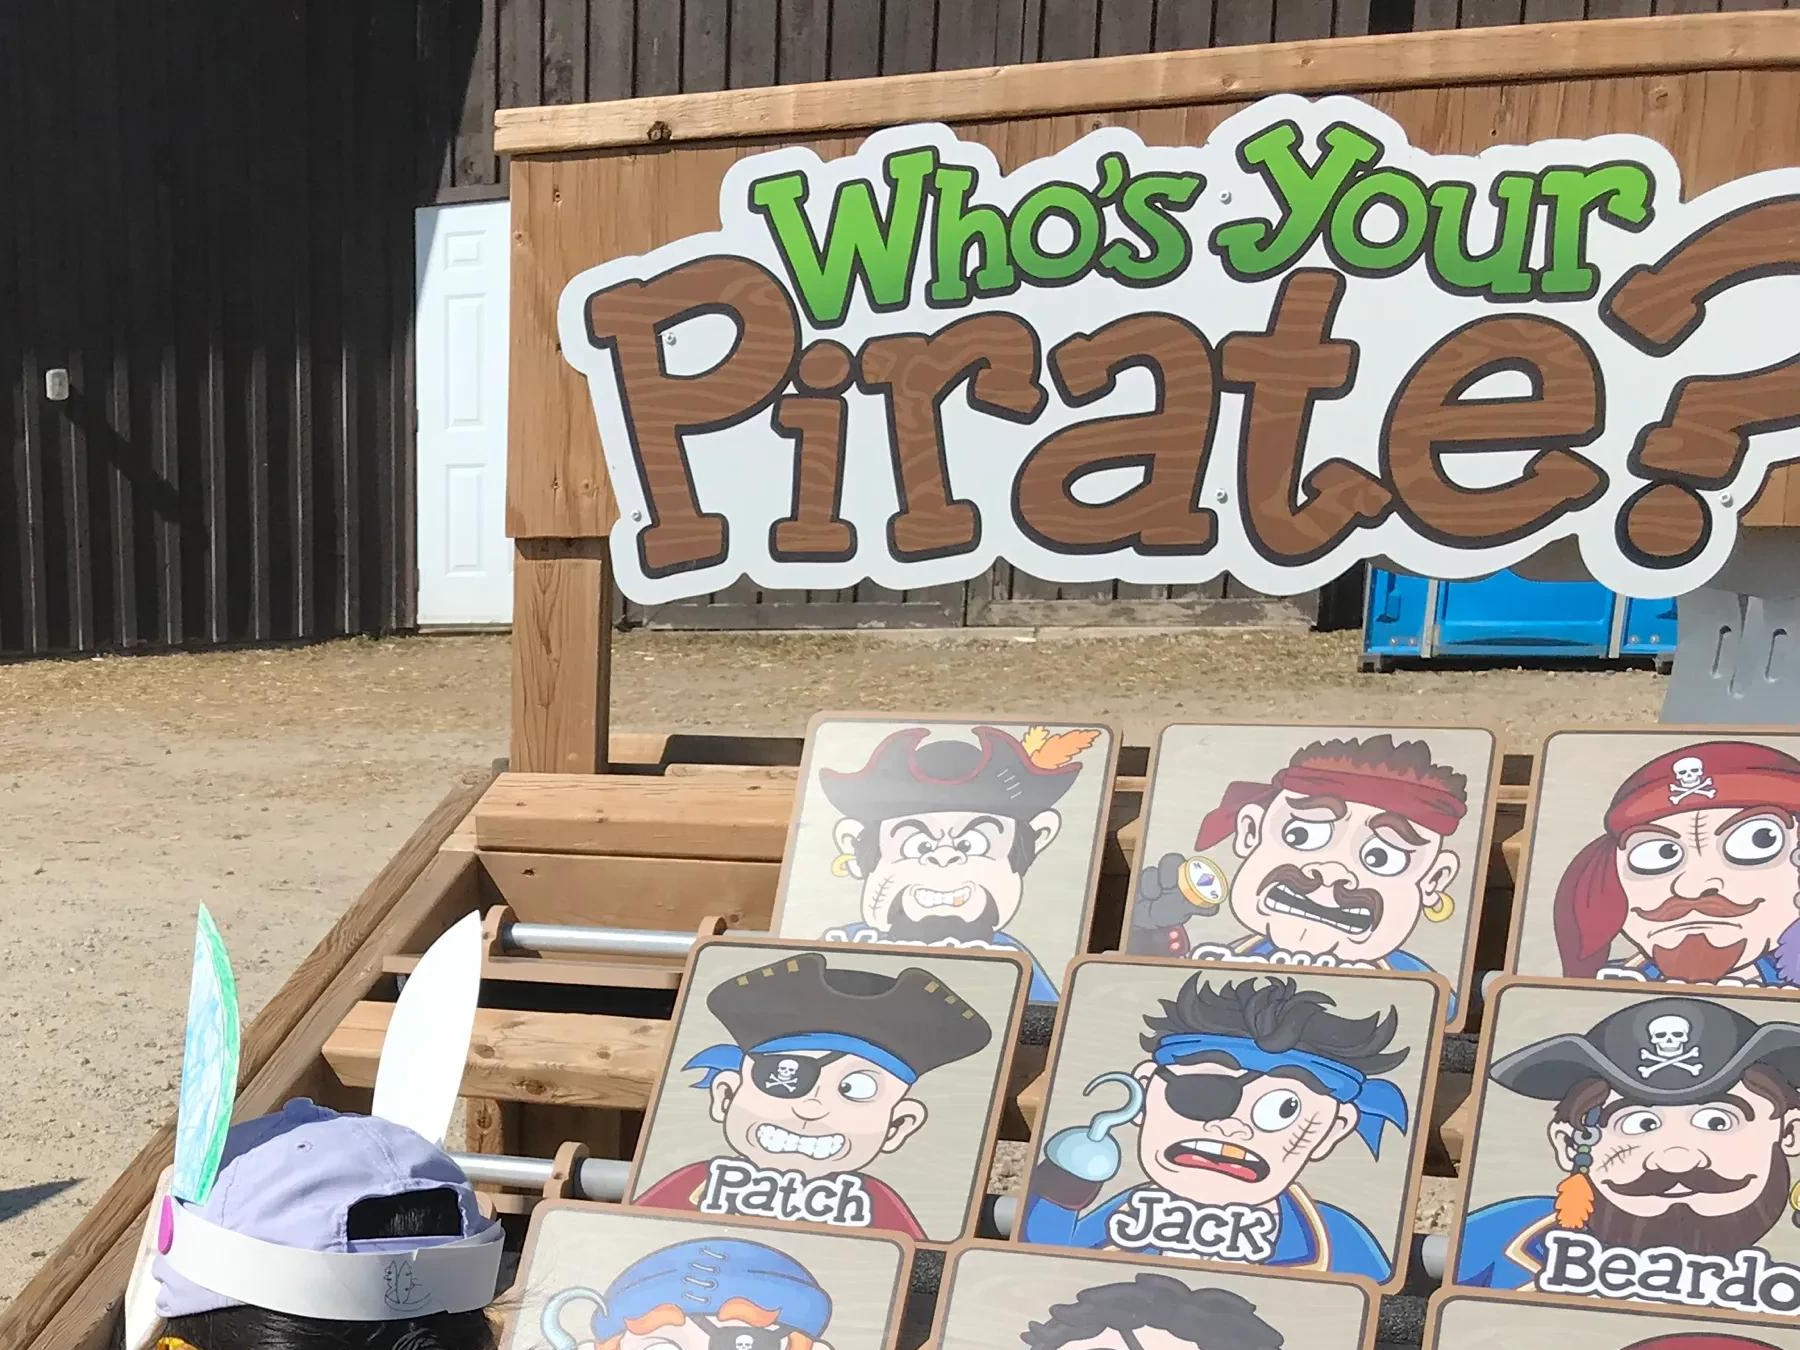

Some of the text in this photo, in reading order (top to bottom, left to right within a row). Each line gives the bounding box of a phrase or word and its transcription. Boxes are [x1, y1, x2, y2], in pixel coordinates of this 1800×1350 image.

[748, 145, 1199, 330] Who's
[587, 194, 1800, 583] Pirate?
[707, 1163, 869, 1223] Patch
[1115, 1198, 1273, 1254] Jack
[1547, 1237, 1800, 1310] Beardo
